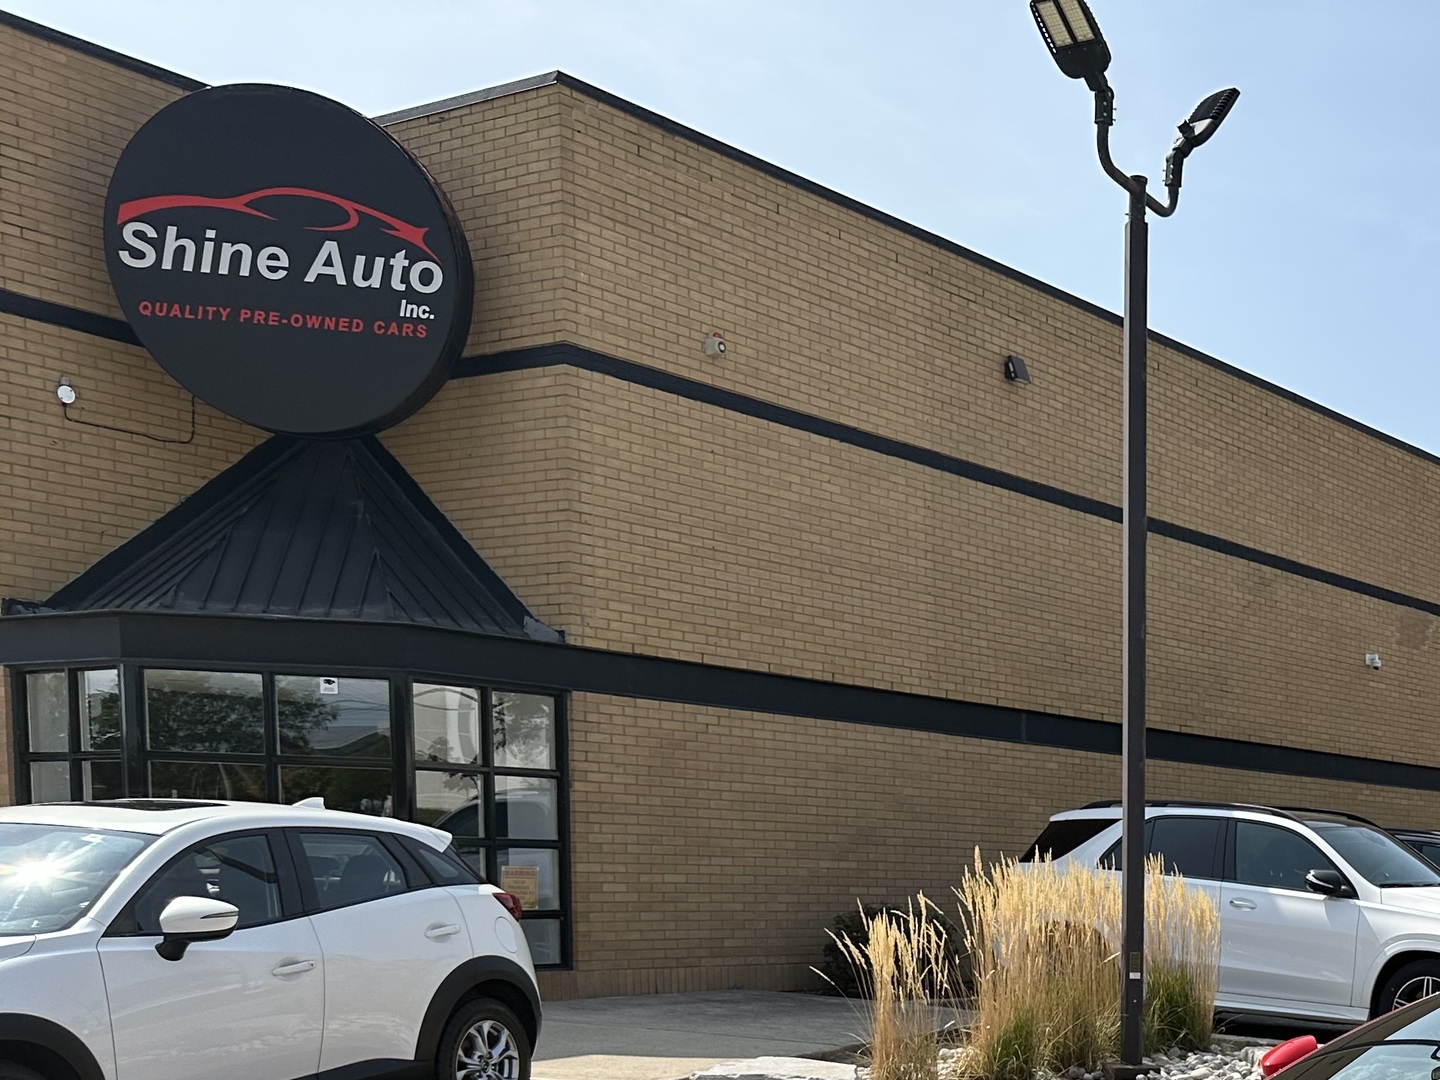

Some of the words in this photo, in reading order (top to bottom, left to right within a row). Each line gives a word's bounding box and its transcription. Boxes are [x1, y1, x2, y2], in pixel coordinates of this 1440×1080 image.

[118, 221, 289, 280] Shine
[303, 240, 444, 294] Auto
[138, 301, 231, 322] QUALITY
[239, 309, 364, 333] PRE-OWNED
[373, 321, 428, 338] CARS
[399, 299, 435, 320] Inc.
